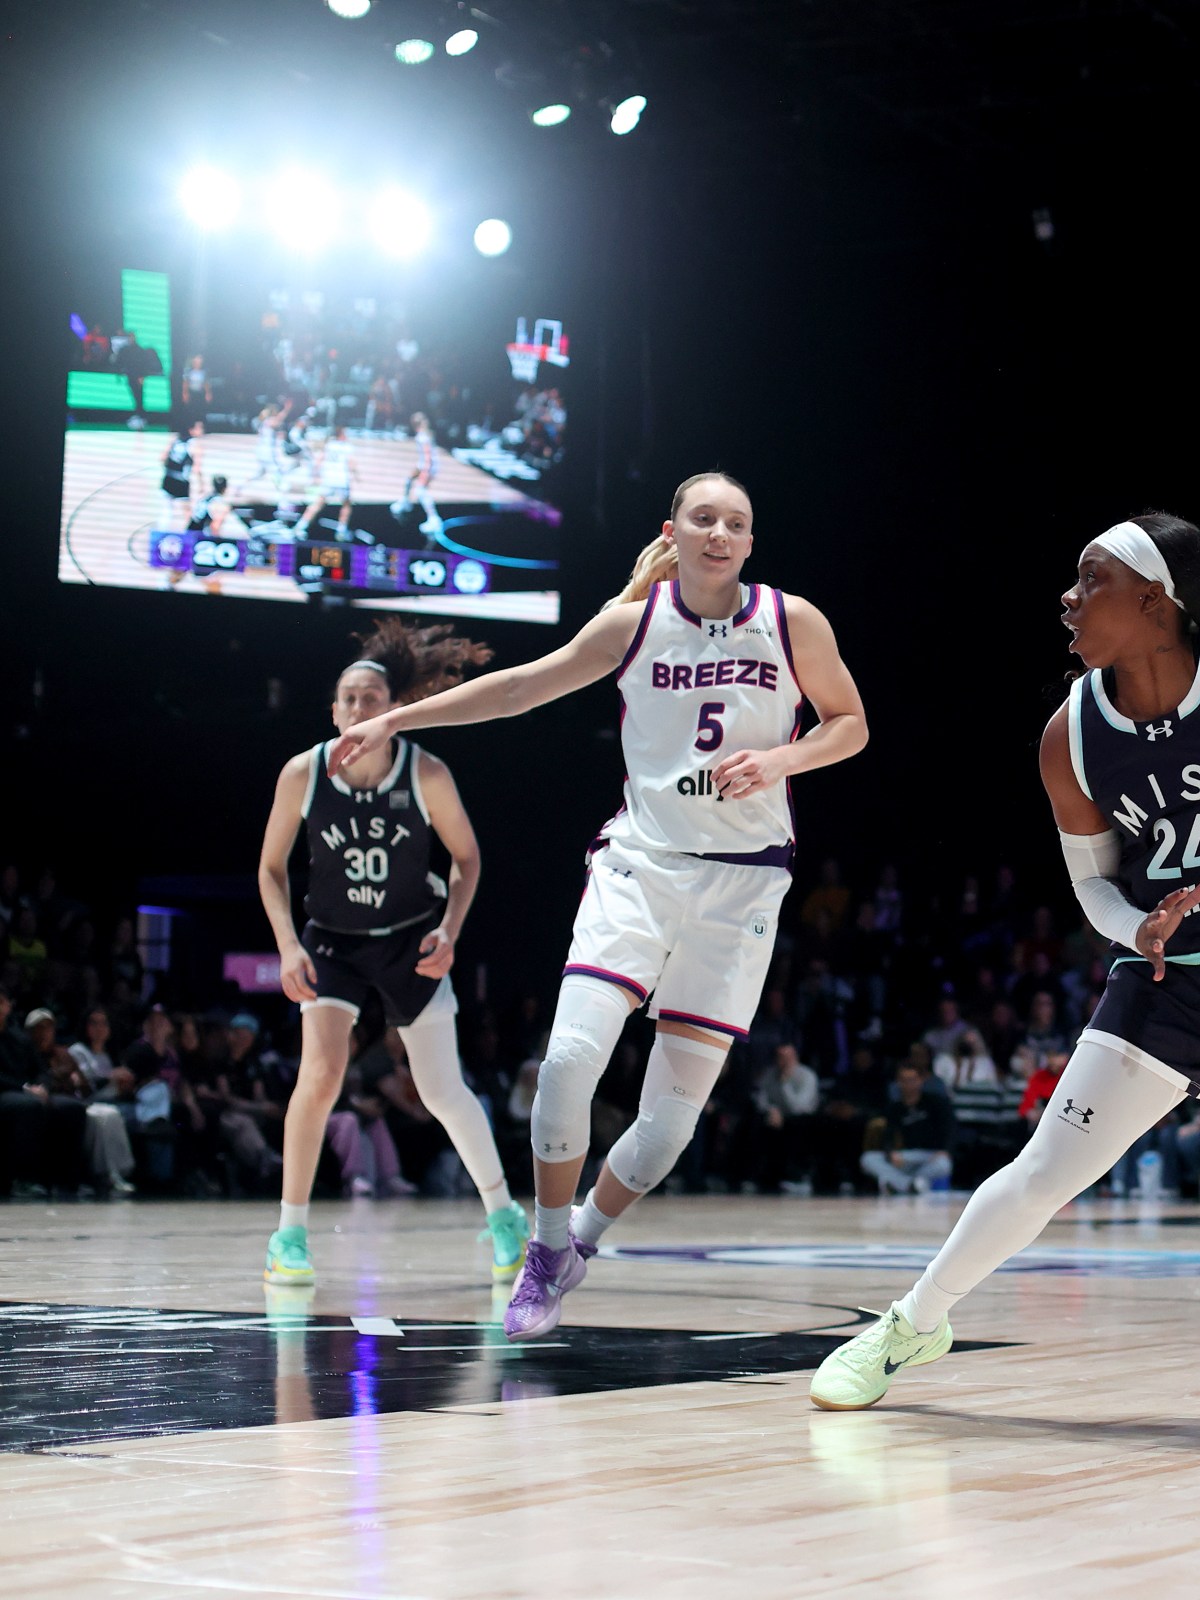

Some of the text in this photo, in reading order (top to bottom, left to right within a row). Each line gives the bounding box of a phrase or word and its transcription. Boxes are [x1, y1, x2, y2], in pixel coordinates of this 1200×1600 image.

[652, 659, 779, 691] BREEZE
[694, 702, 726, 752] 5
[320, 815, 411, 851] MIST
[343, 847, 389, 883] 30
[346, 885, 387, 910] ally
